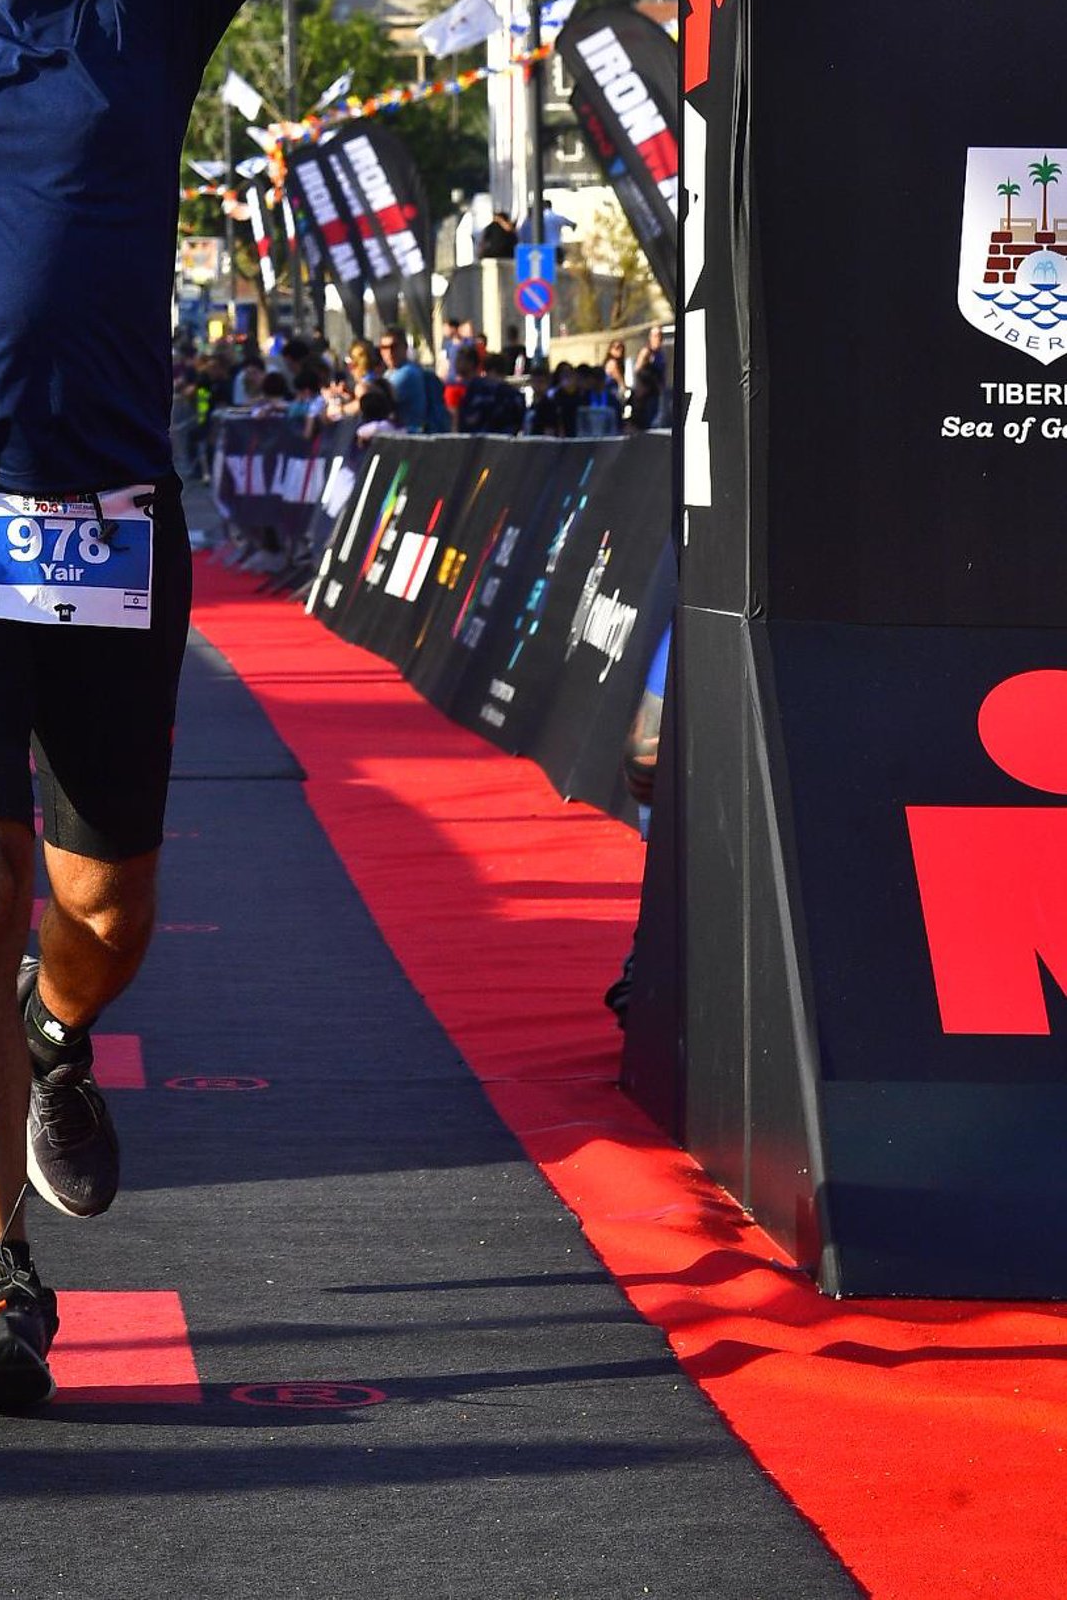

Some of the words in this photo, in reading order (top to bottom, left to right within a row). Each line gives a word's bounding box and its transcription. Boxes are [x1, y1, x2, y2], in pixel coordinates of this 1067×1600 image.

[576, 26, 679, 222] IRONM
[941, 415, 994, 438] Sea
[1003, 416, 1037, 444] of
[34, 502, 59, 514] 70.3
[7, 517, 110, 564] 978
[40, 563, 85, 582] Yair
